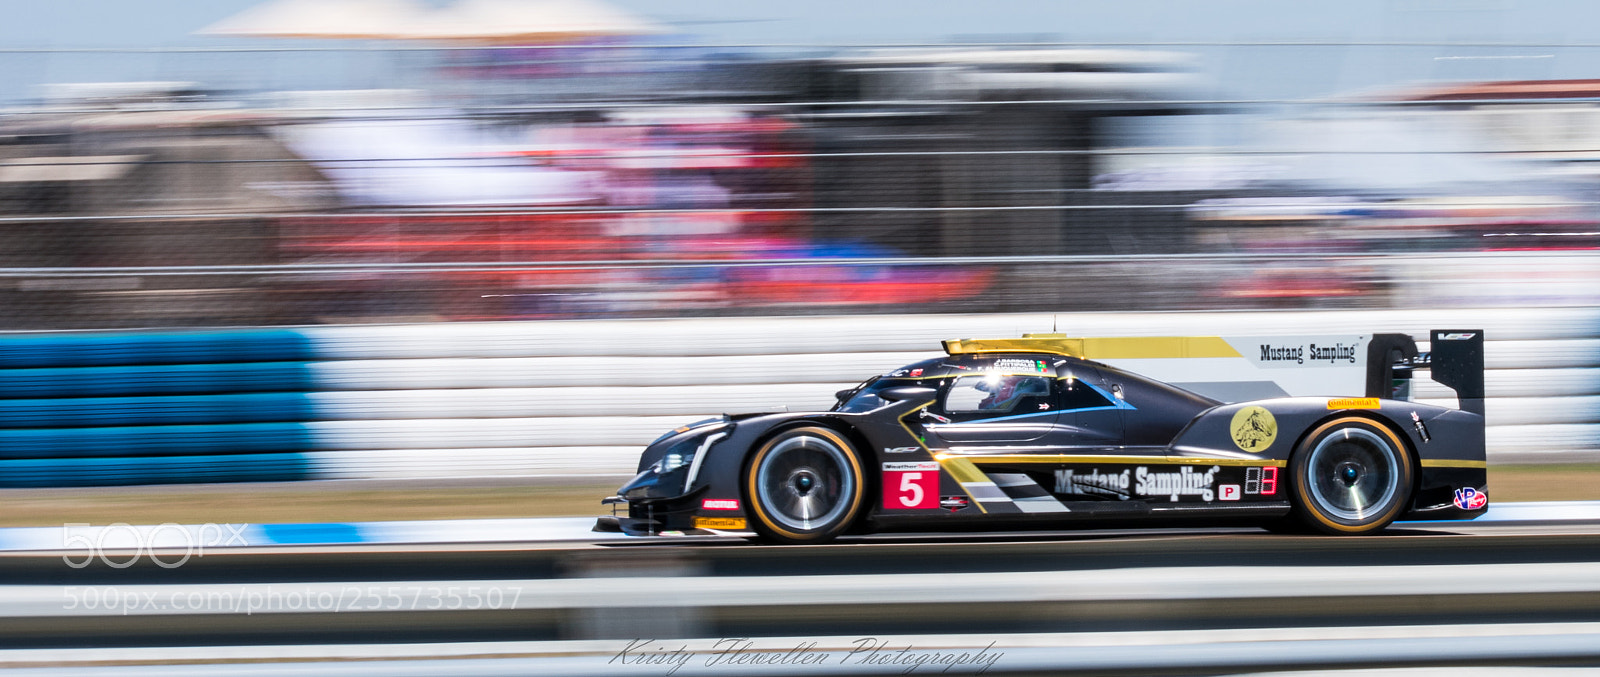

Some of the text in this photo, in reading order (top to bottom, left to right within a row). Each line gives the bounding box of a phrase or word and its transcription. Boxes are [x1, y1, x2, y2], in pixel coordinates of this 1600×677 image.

[1260, 342, 1355, 364] Mustang Sampling
[899, 472, 925, 508] 5
[1054, 466, 1214, 502] Mustang Sampling
[1225, 487, 1234, 498] P
[1455, 487, 1476, 509] VP
